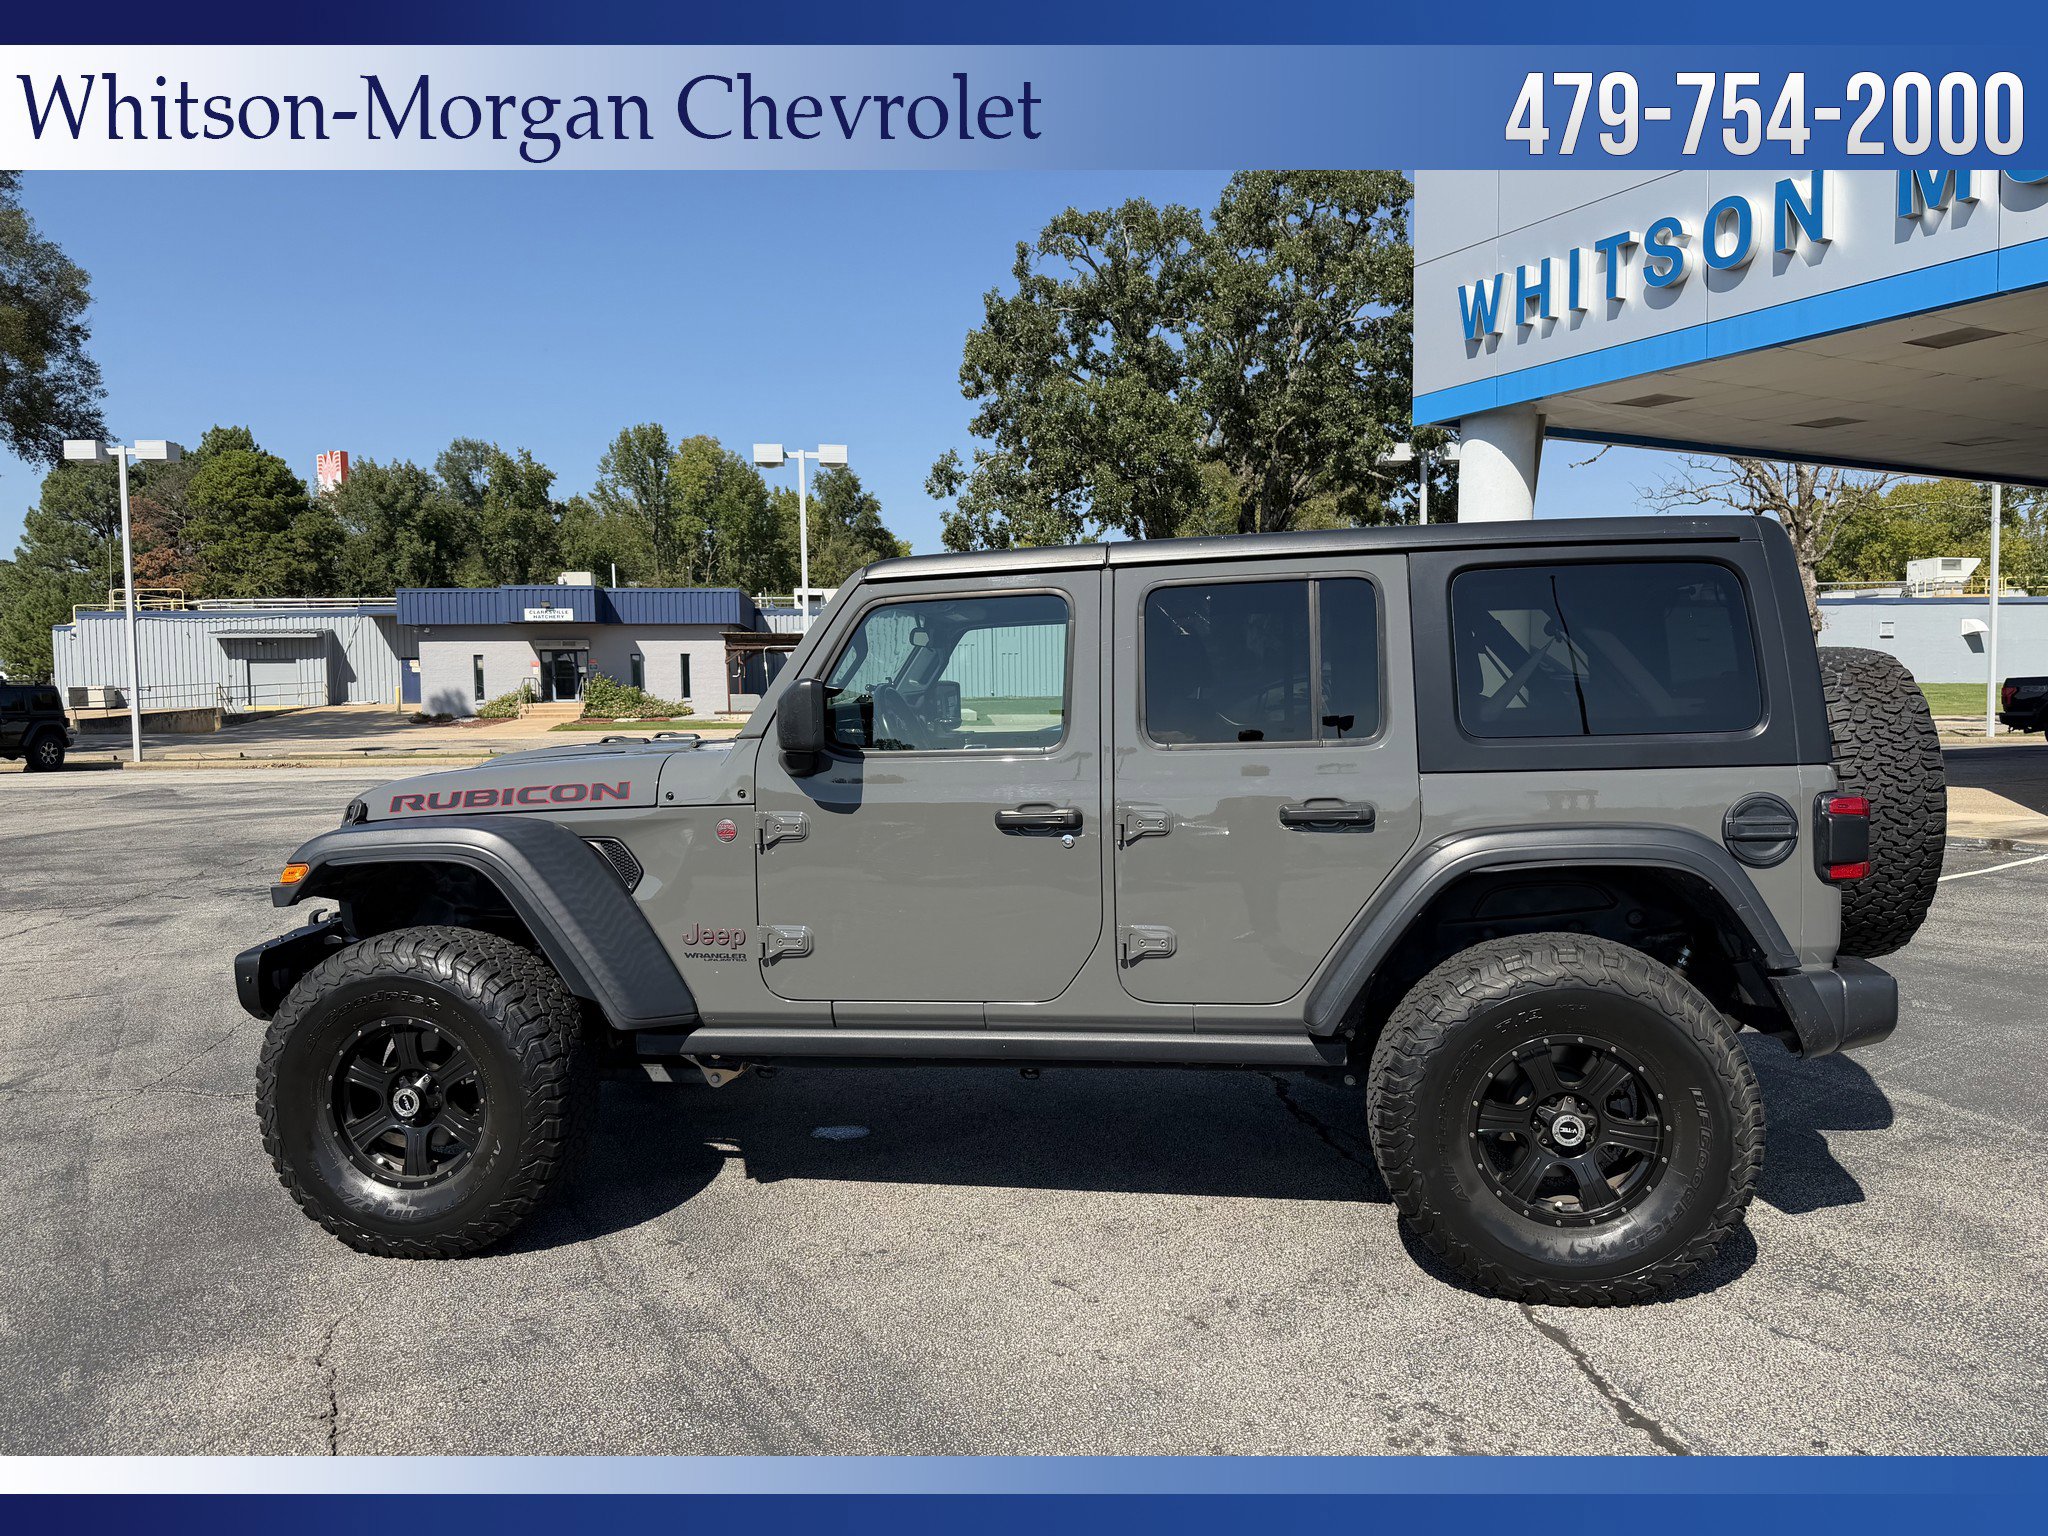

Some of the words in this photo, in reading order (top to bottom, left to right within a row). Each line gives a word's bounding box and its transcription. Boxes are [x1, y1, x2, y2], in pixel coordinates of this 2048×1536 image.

[1457, 170, 1833, 342] WHITSON
[389, 781, 631, 813] RUBICON
[682, 923, 746, 949] Jeep
